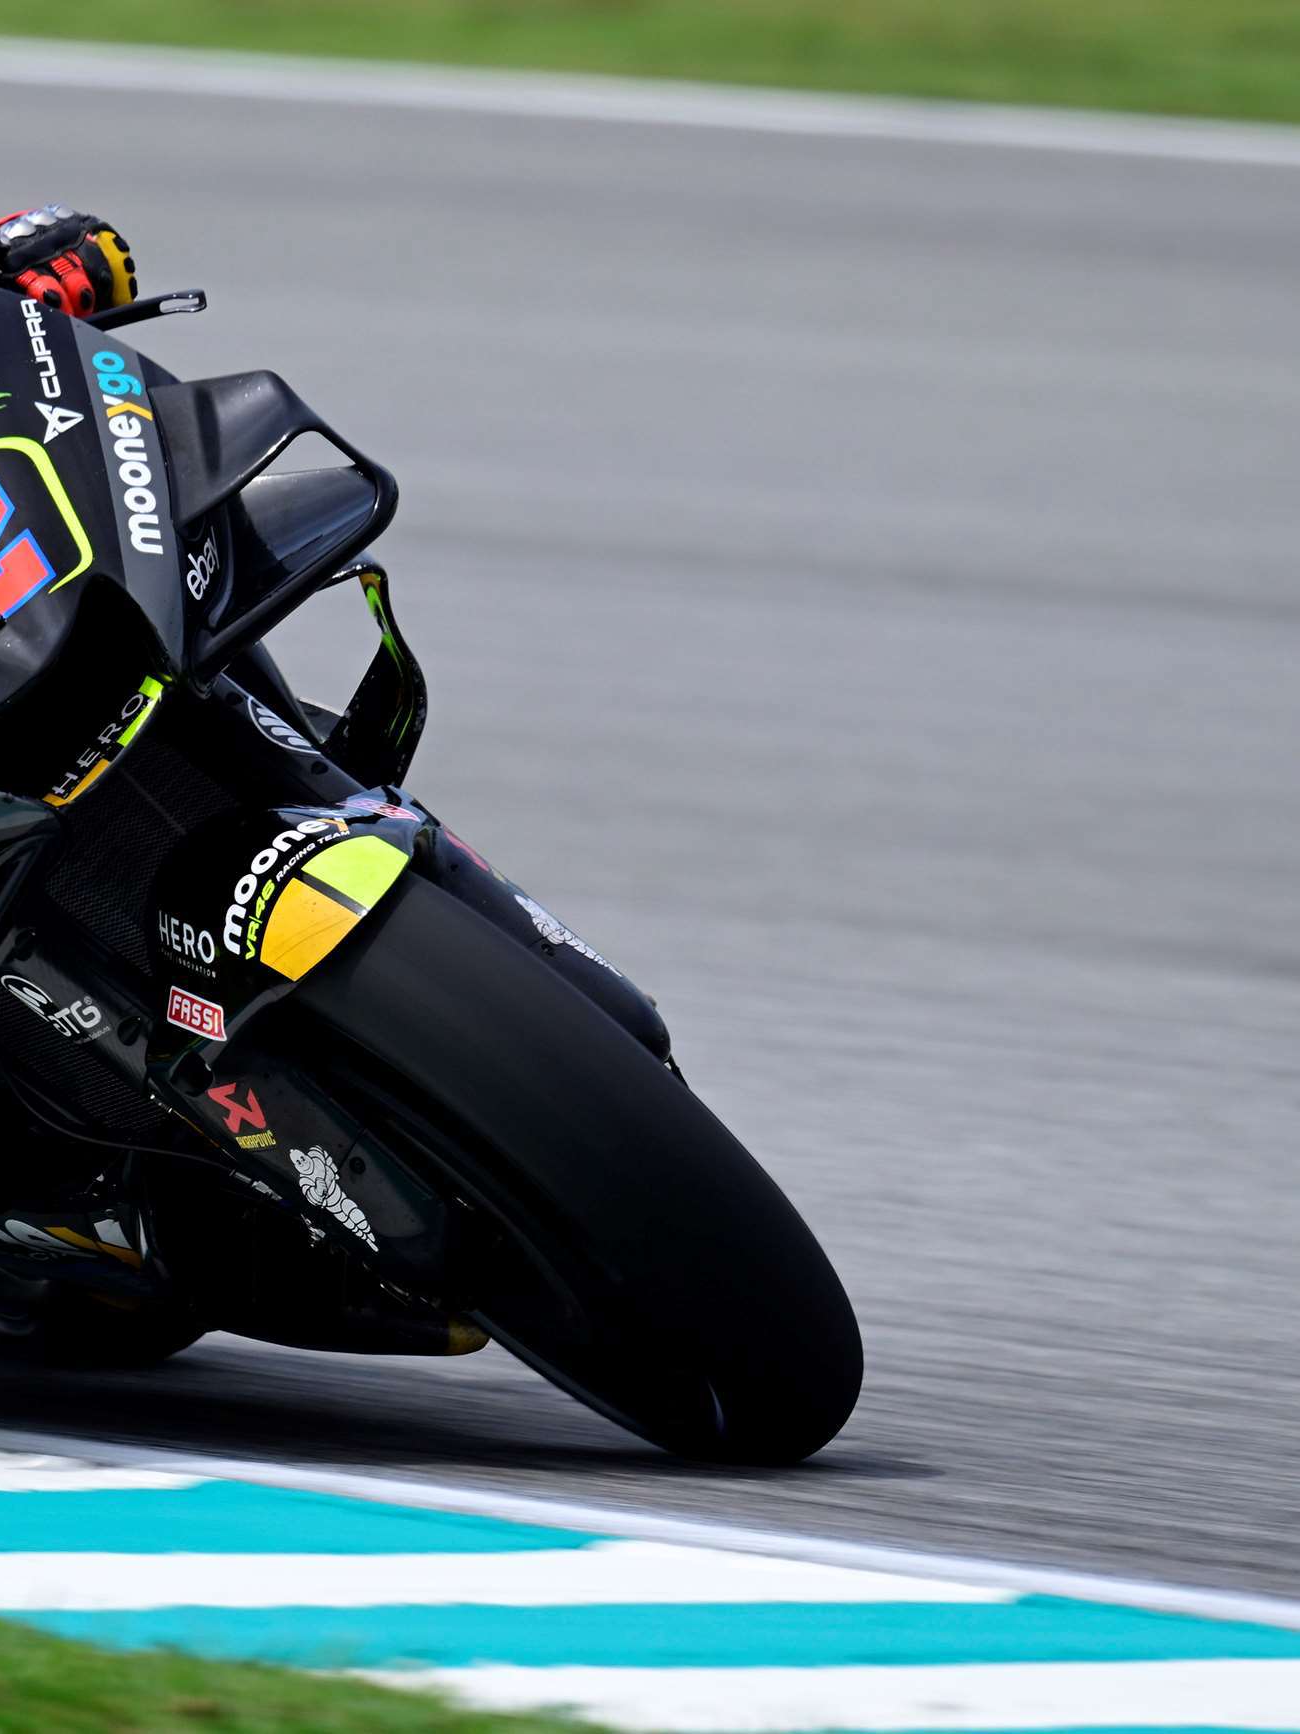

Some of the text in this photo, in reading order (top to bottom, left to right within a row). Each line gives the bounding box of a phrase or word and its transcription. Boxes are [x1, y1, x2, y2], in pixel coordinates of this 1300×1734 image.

[20, 298, 62, 399] CUPRA
[91, 350, 164, 555] mooneygo
[186, 535, 221, 601] ebay
[51, 693, 144, 795] HERO
[222, 816, 350, 955] mooney
[275, 842, 316, 882] RACING
[317, 829, 351, 845] TEAM
[158, 909, 216, 964] HERO
[171, 994, 219, 1035] FASSI
